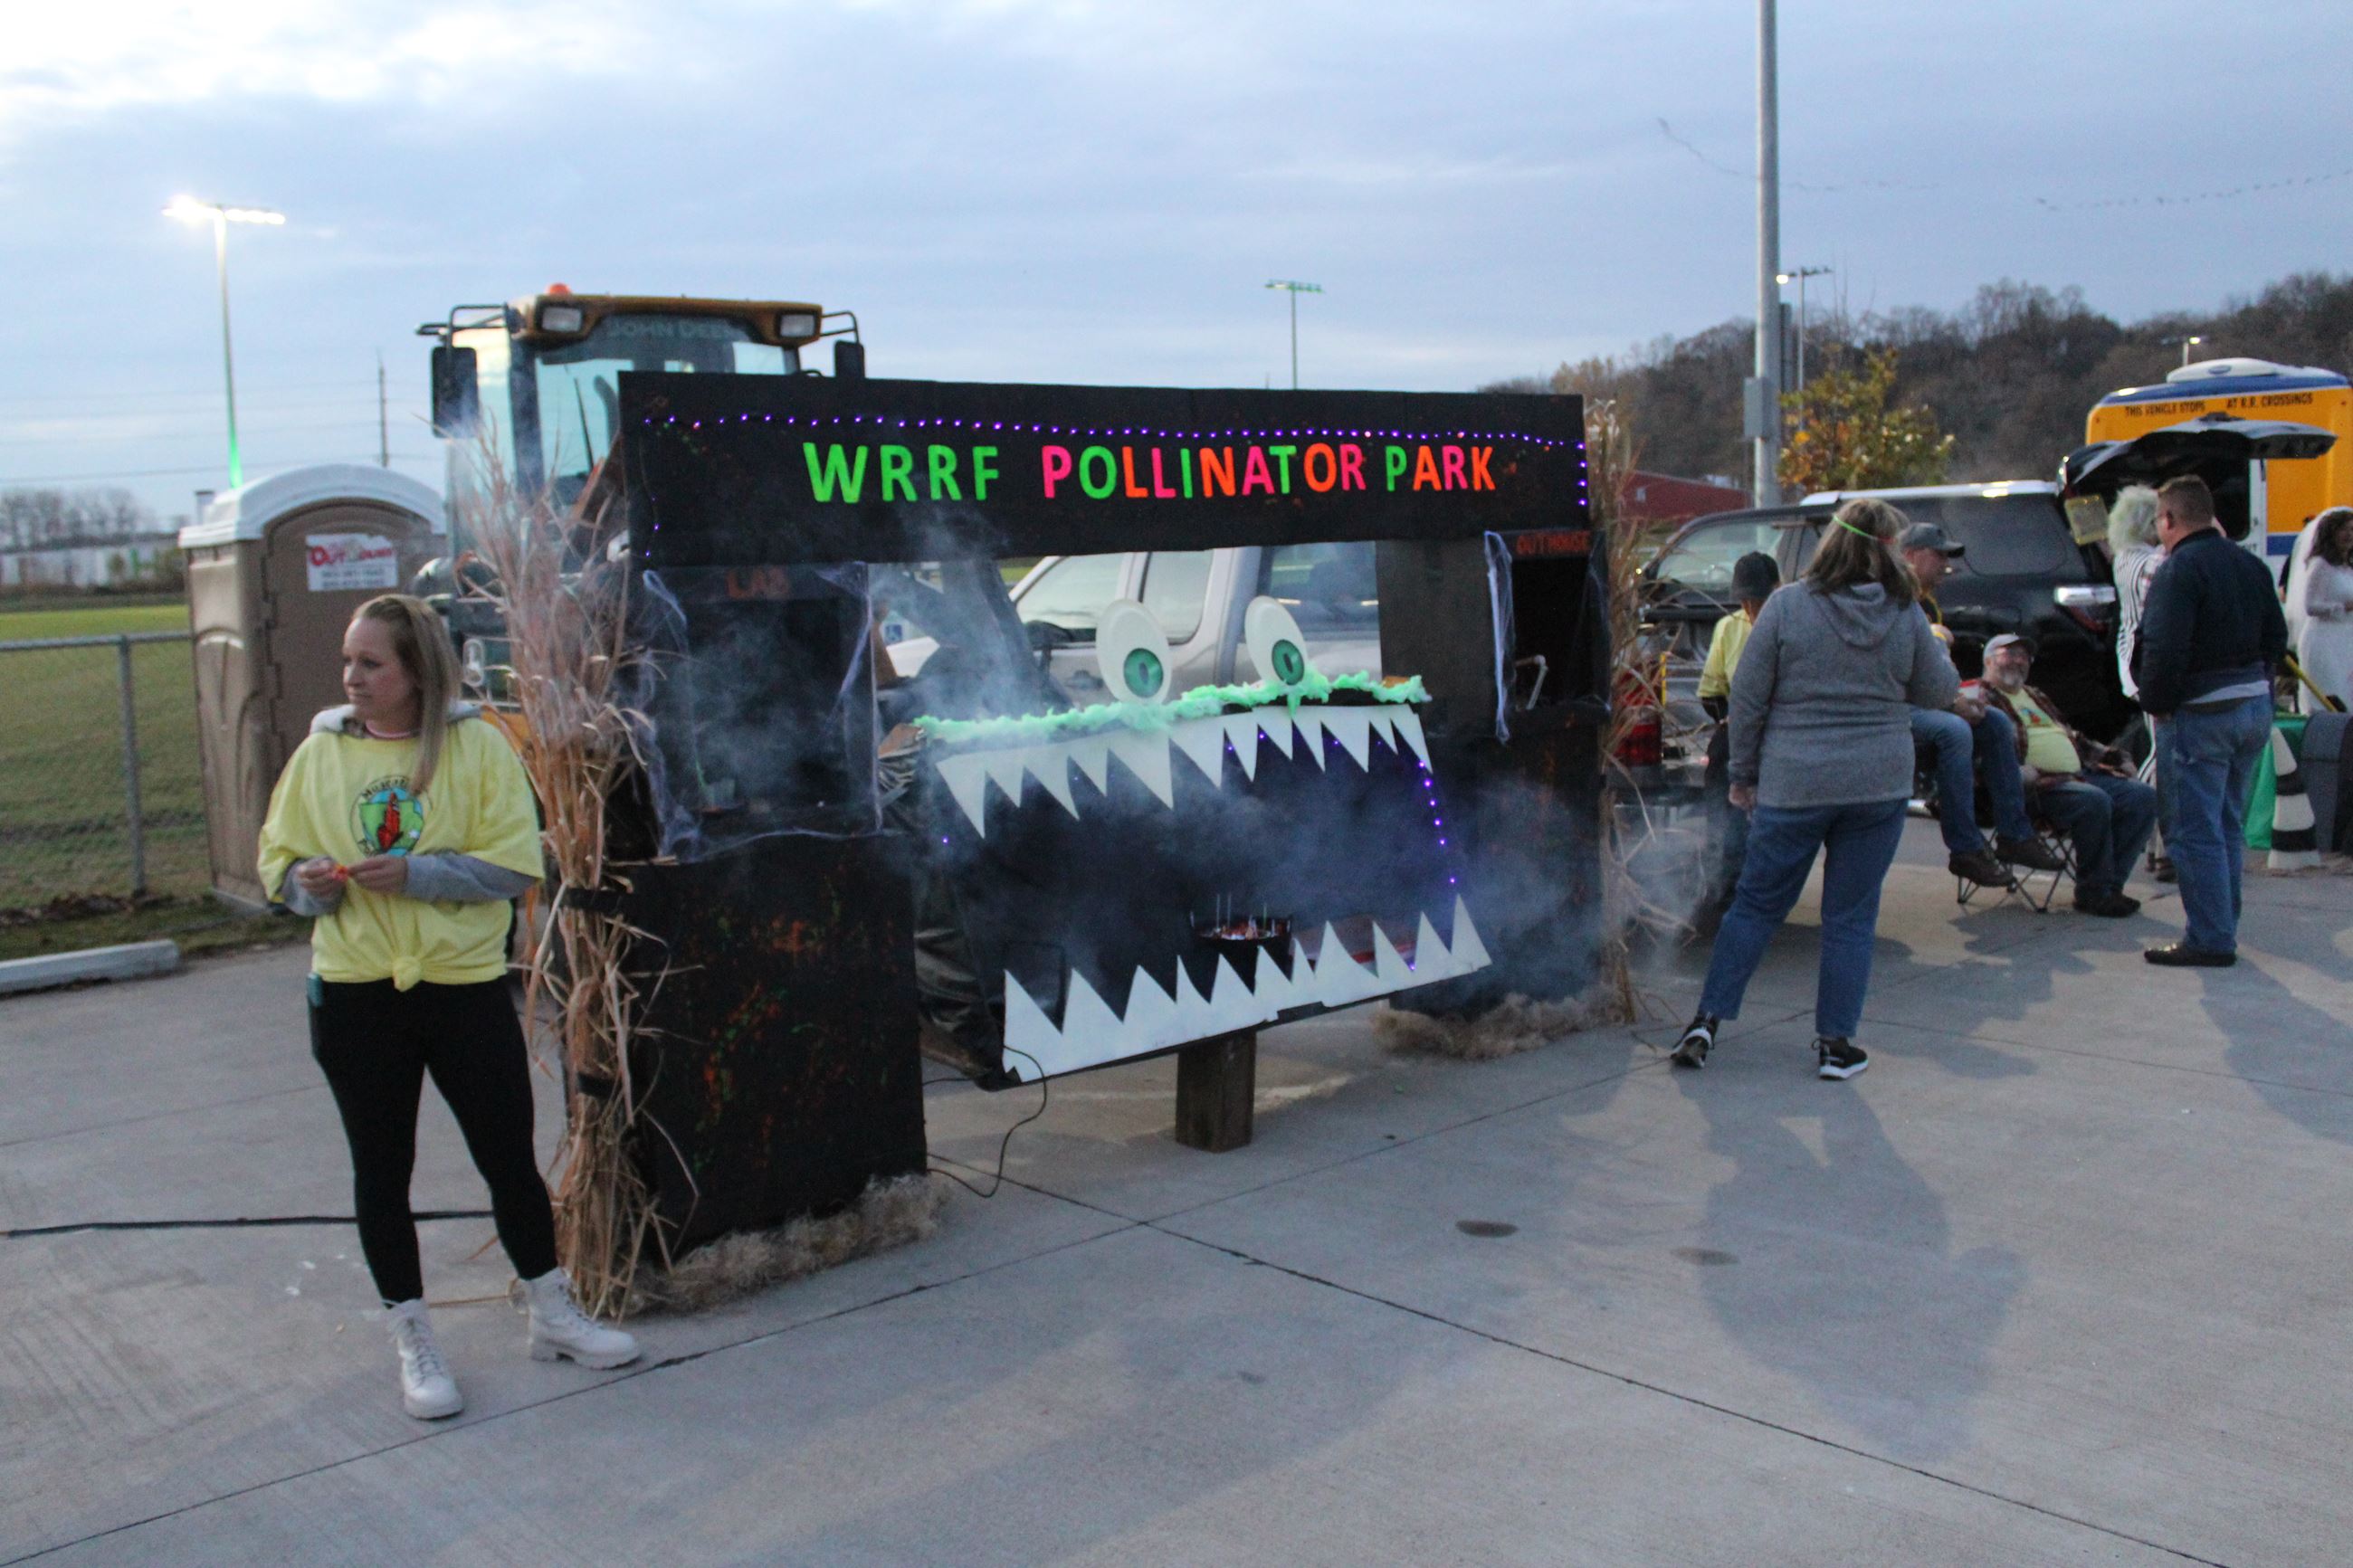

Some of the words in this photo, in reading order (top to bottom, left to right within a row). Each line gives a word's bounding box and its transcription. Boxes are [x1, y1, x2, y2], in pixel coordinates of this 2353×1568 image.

[2125, 405, 2143, 417] THIS
[2146, 403, 2177, 416] VEHICLE
[2180, 400, 2206, 413] STOPS
[2226, 397, 2237, 409] AT
[2262, 393, 2314, 407] CROSSINGS
[803, 442, 999, 503] WRRF
[1042, 442, 1367, 499] POLLINATOR
[1385, 444, 1497, 492] PARK
